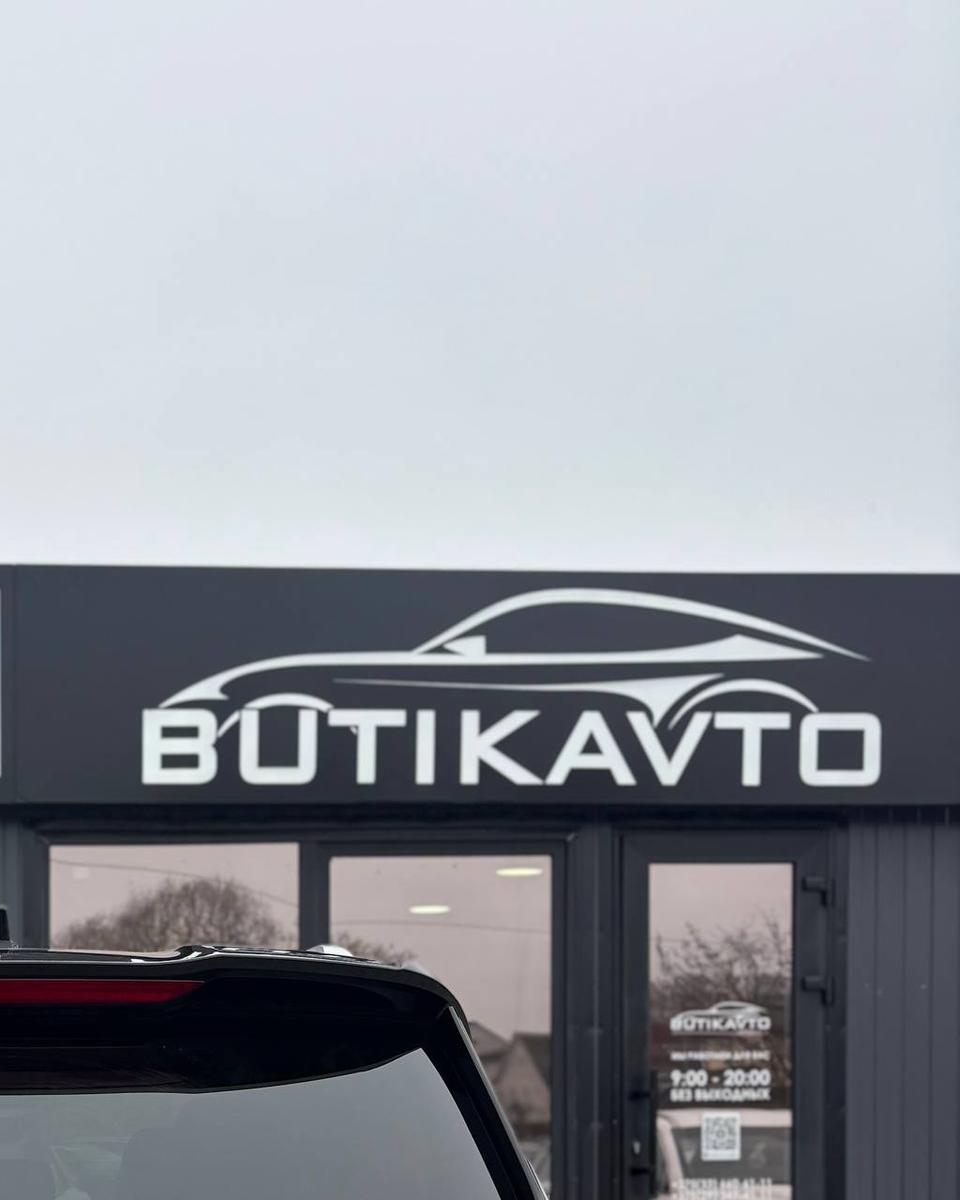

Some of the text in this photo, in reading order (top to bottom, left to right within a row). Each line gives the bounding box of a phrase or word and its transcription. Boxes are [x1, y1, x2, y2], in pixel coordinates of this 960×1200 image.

[142, 708, 881, 786] BUTIKAVTO
[670, 1016, 771, 1032] BUTIKAVTO
[670, 1068, 709, 1088] 9:00
[723, 1068, 772, 1087] 20:00
